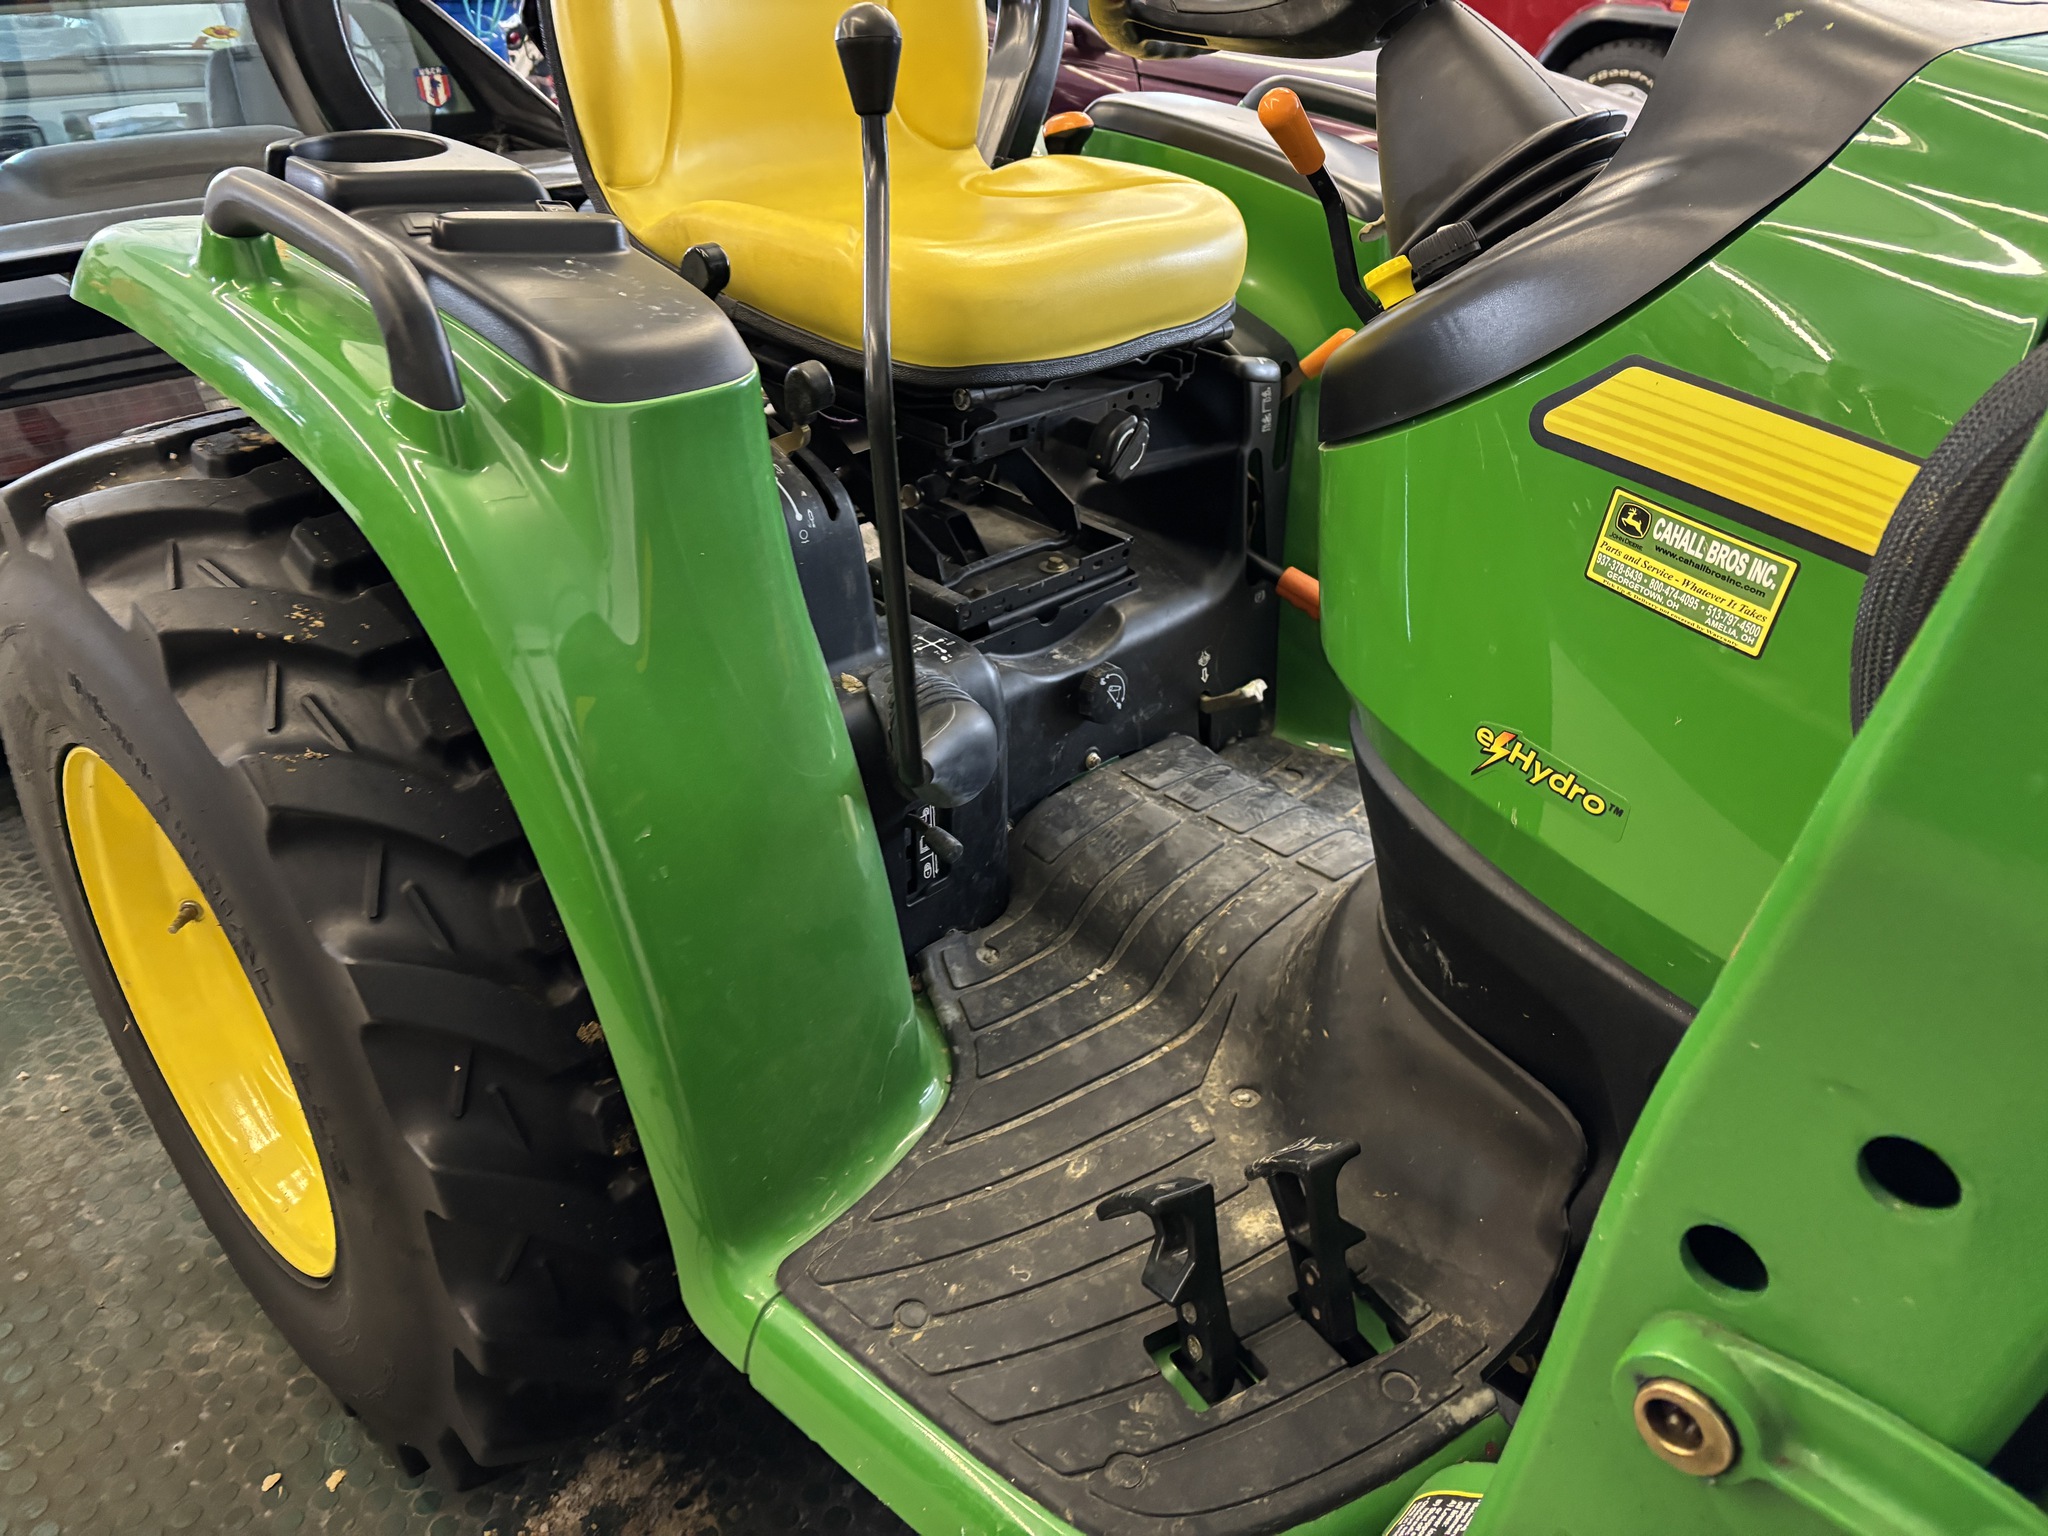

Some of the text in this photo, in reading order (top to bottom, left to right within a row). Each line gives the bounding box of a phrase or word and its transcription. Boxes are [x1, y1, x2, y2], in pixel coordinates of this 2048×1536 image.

[1609, 532, 1644, 551] JOHN DEERE
[1653, 517, 1778, 590] CAHALL BROS INC.
[1596, 553, 1762, 638] 937-378-6439 800-474-4095 513-797-4500
[1600, 540, 1622, 556] Parts
[1623, 553, 1641, 565] and
[1641, 560, 1674, 580] Service
[1681, 578, 1726, 604] Whatever
[1727, 599, 1738, 609] It
[1739, 603, 1768, 622] Takes
[1606, 570, 1680, 611] GEORGETOWN, OH
[1704, 617, 1756, 645] AMELIA, OH
